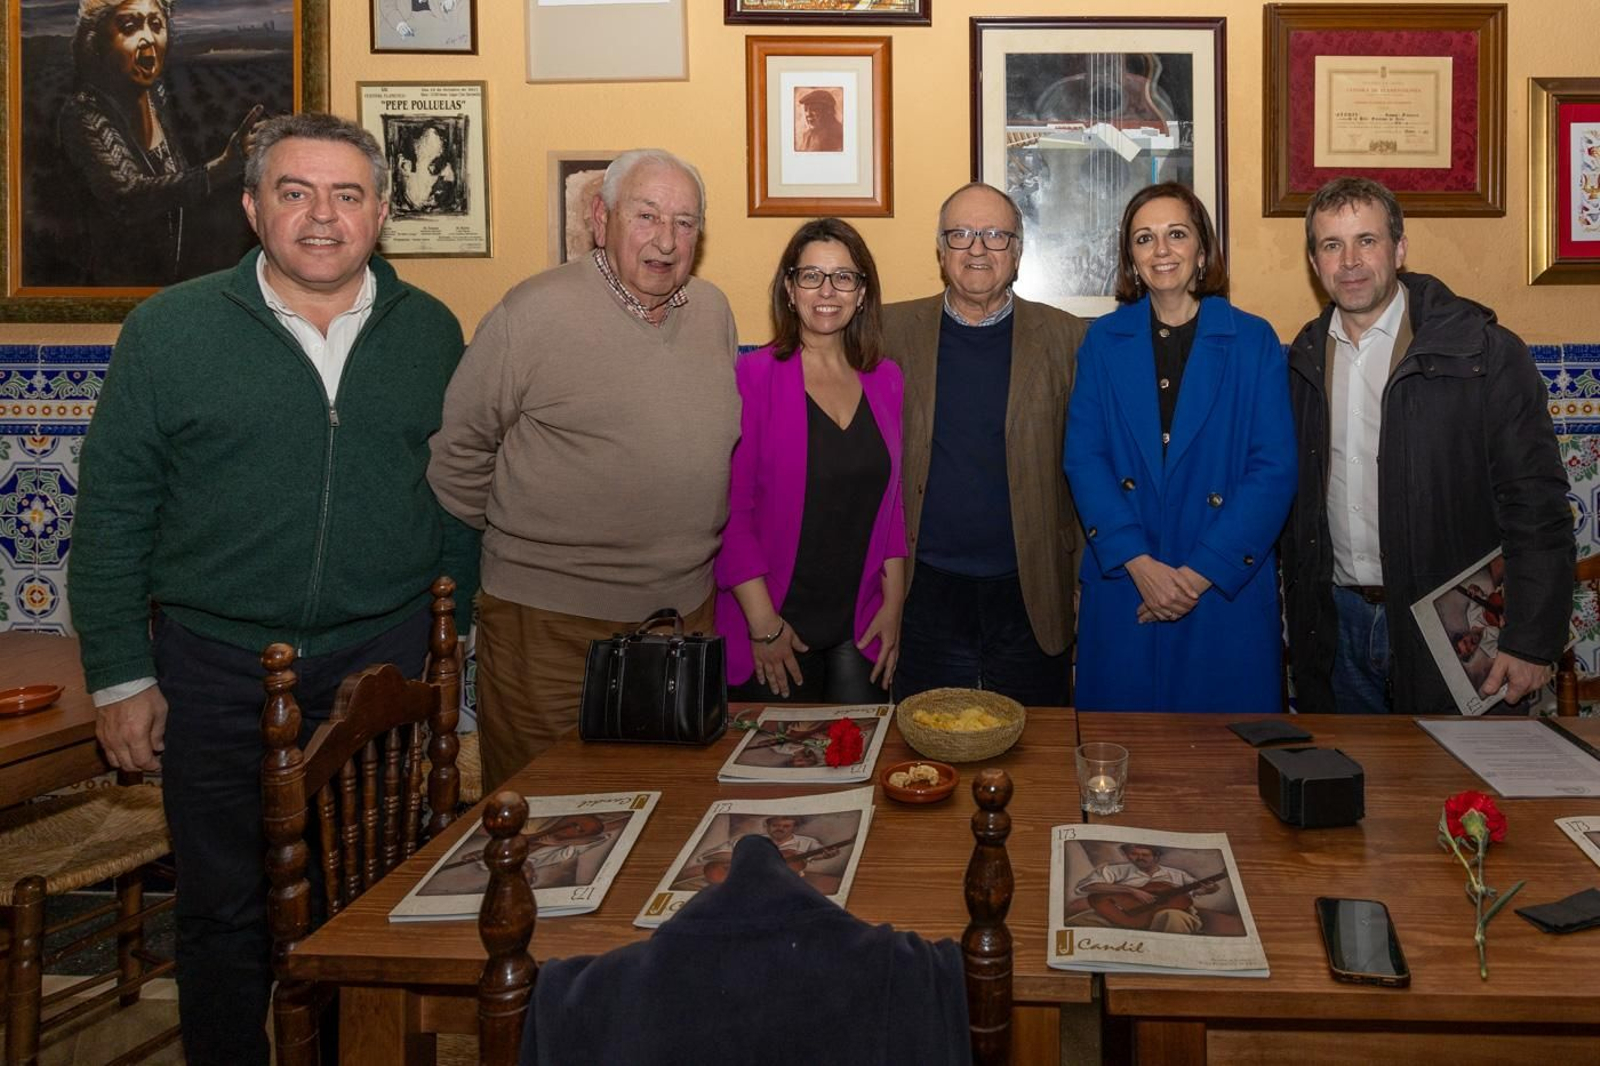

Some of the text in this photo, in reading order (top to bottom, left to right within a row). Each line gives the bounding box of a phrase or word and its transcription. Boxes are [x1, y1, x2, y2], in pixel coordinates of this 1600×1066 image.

[381, 100, 466, 110] "PEPE POLLUELAS"
[577, 797, 632, 808] Candil
[1566, 820, 1590, 832] 173
[1058, 828, 1076, 840] 173
[571, 887, 595, 900] 173
[1077, 938, 1145, 954] Candil
